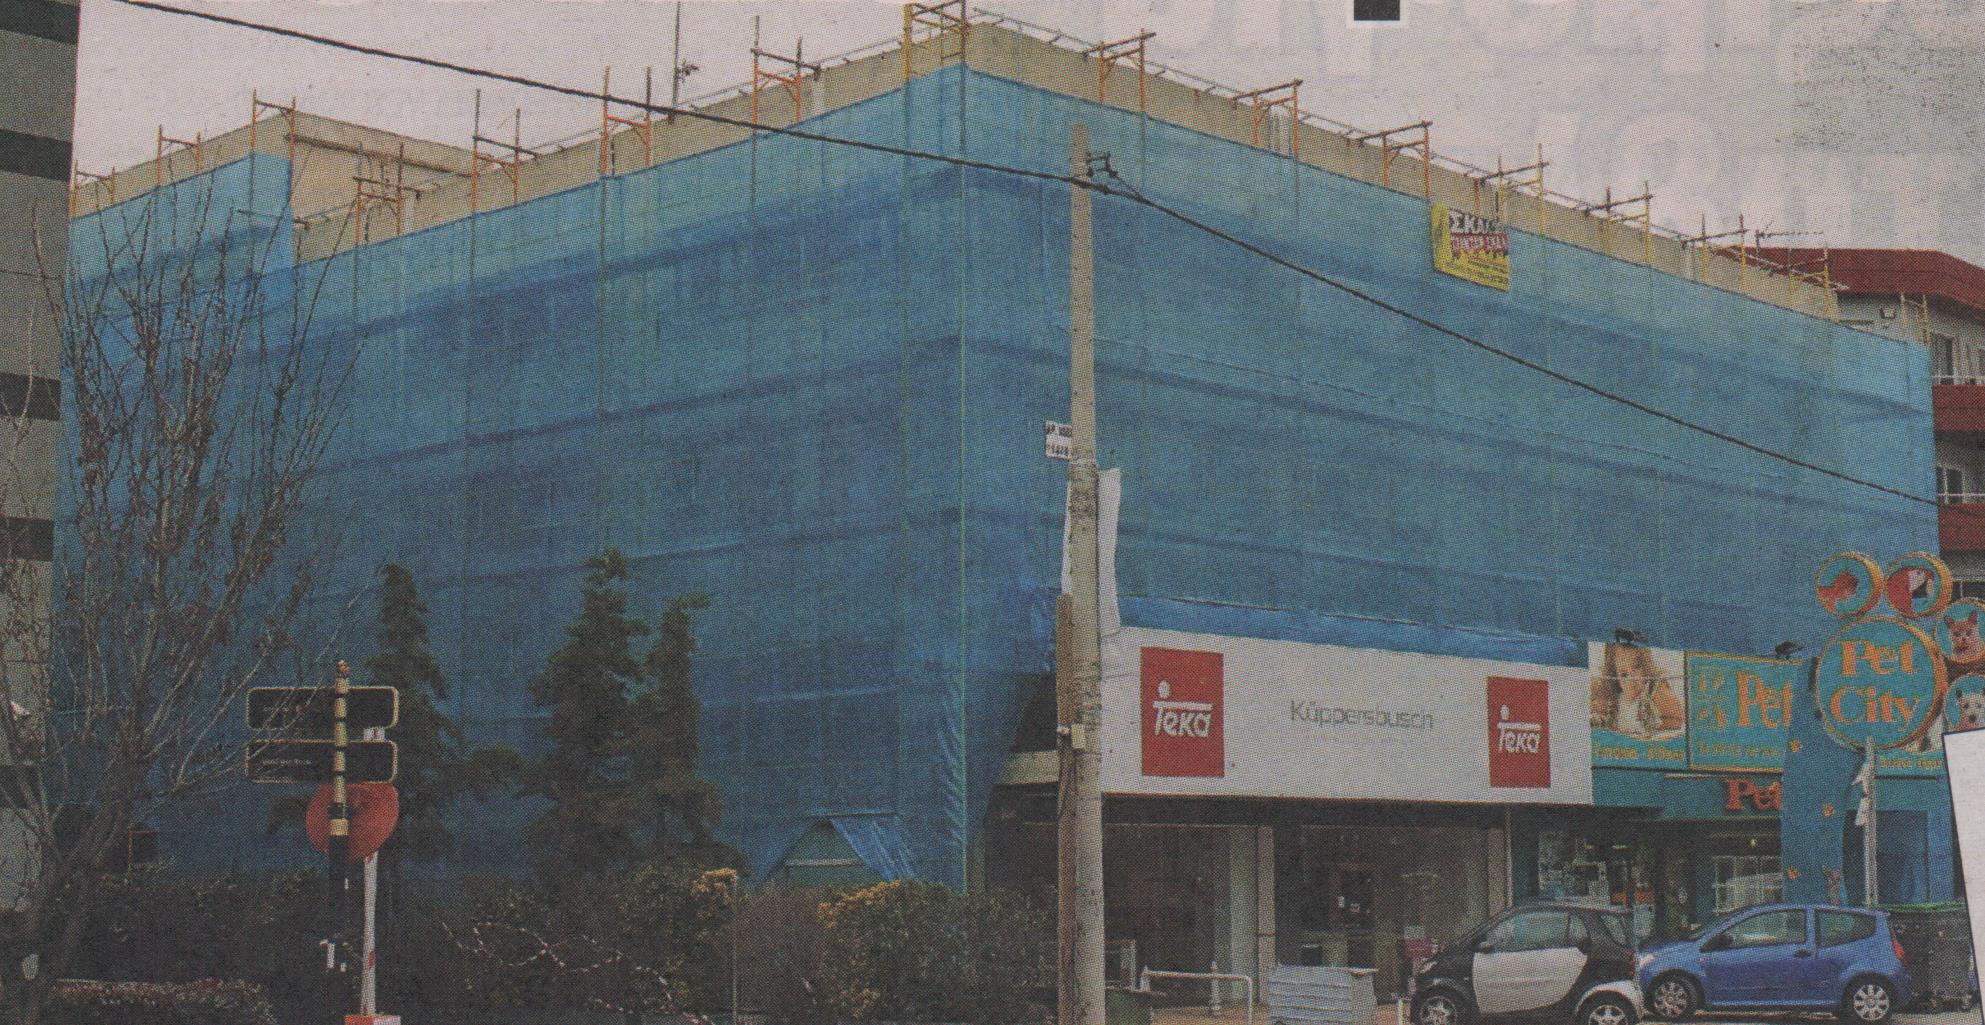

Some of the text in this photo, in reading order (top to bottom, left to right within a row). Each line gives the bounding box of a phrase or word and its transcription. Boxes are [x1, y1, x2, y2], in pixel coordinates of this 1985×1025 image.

[1839, 638, 1917, 677] Pet
[1290, 700, 1434, 730] Küppersbusch
[1830, 685, 1921, 731] City
